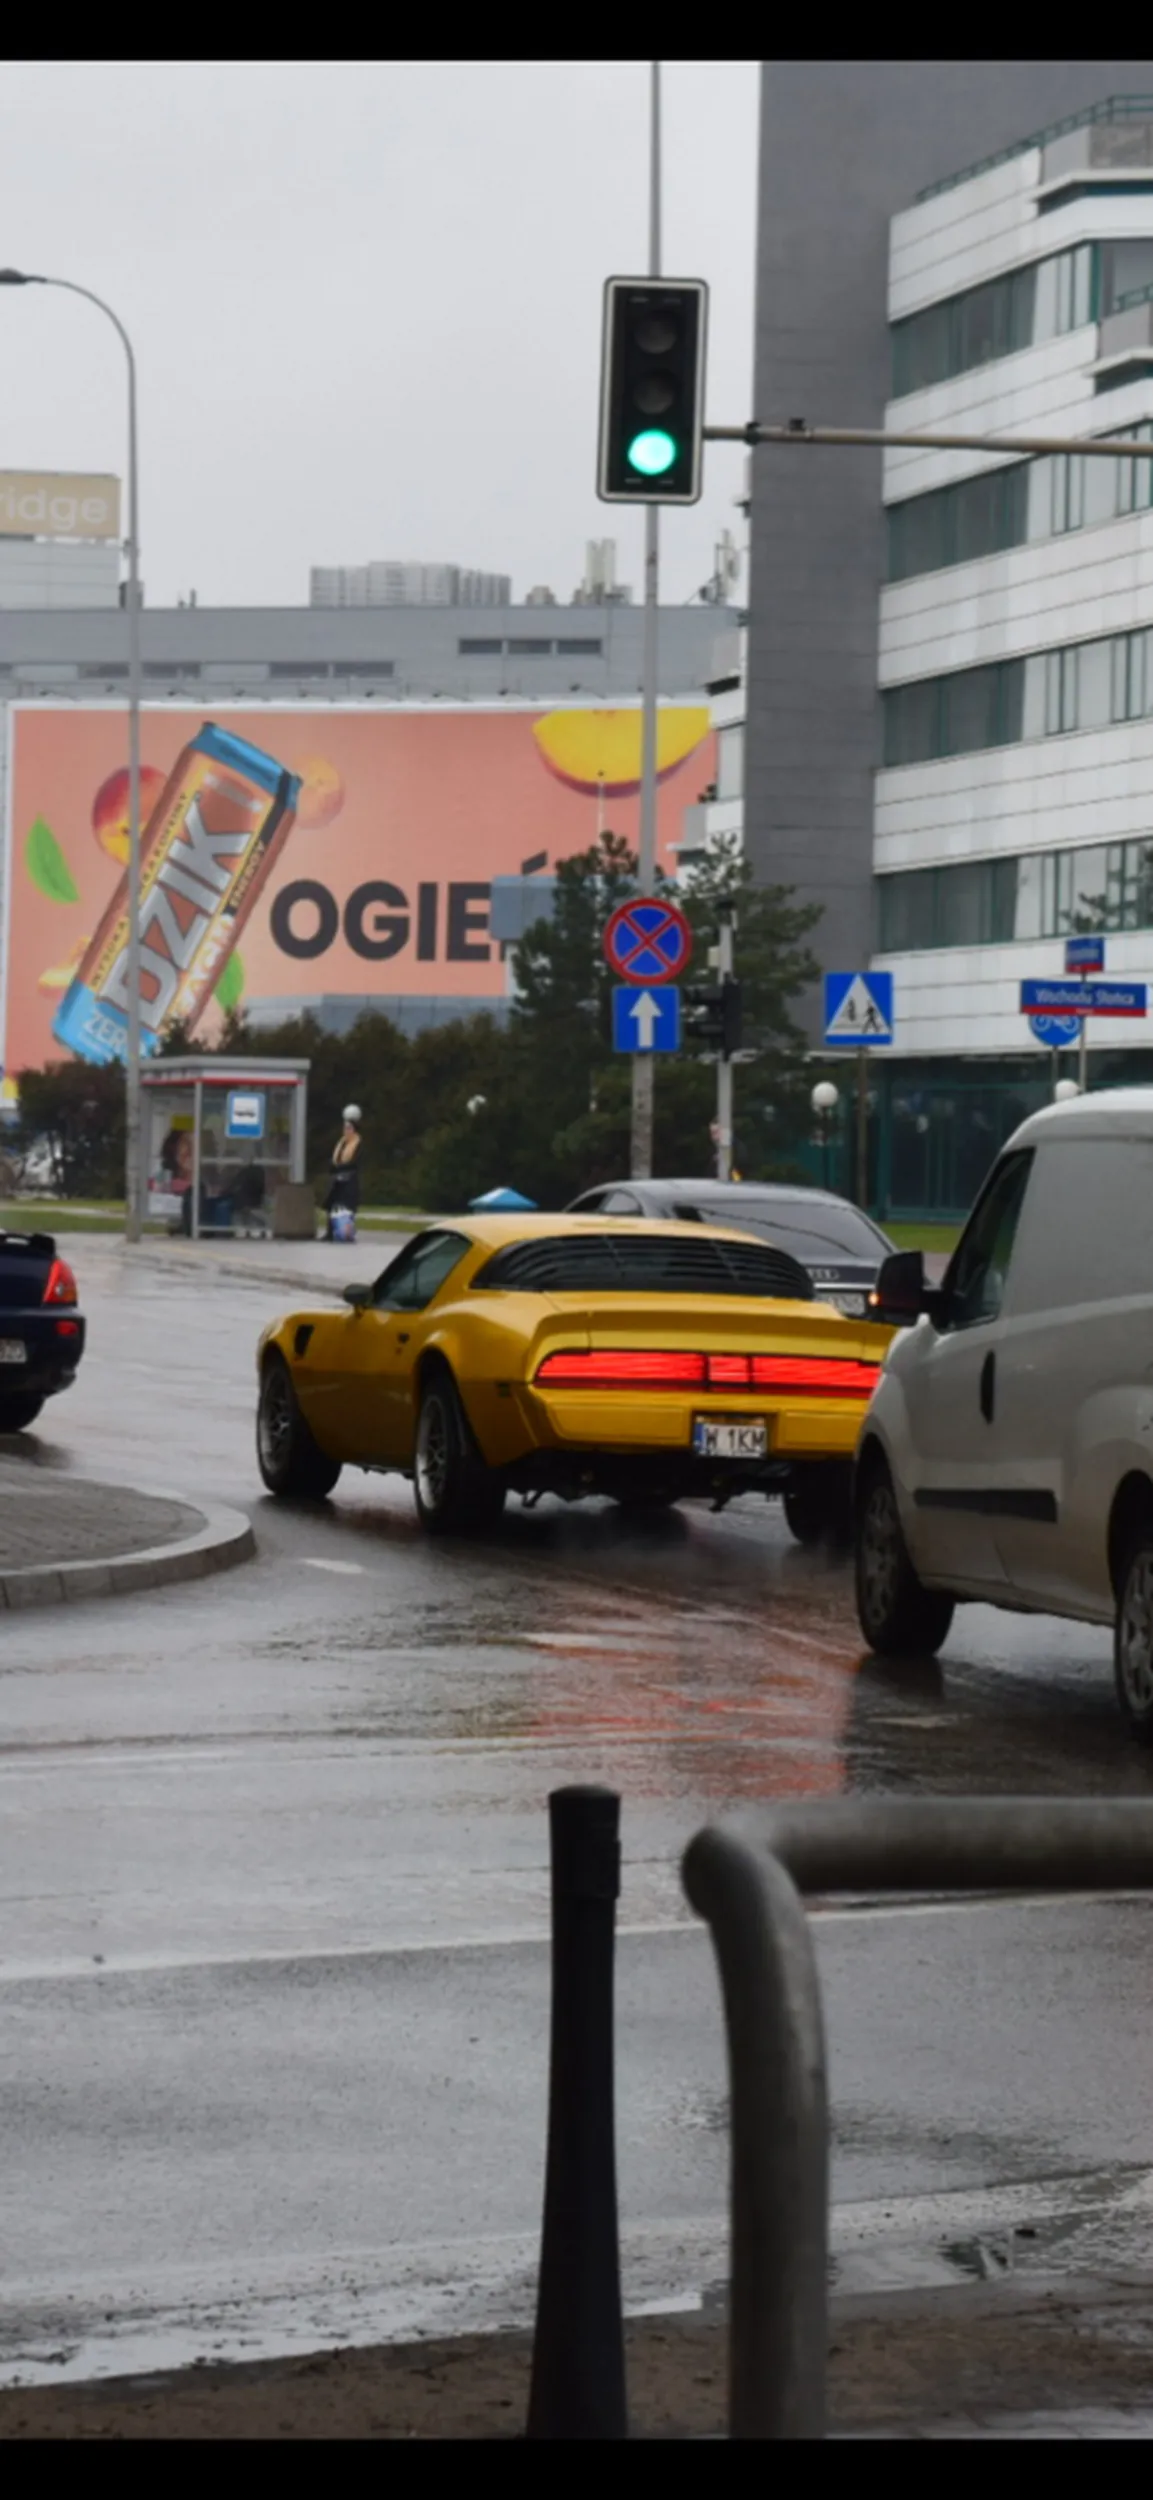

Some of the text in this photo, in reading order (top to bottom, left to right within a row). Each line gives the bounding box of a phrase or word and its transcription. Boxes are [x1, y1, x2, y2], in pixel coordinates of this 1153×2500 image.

[0, 485, 107, 532] idge
[96, 797, 251, 1032] DZIK
[269, 850, 548, 962] OGIE
